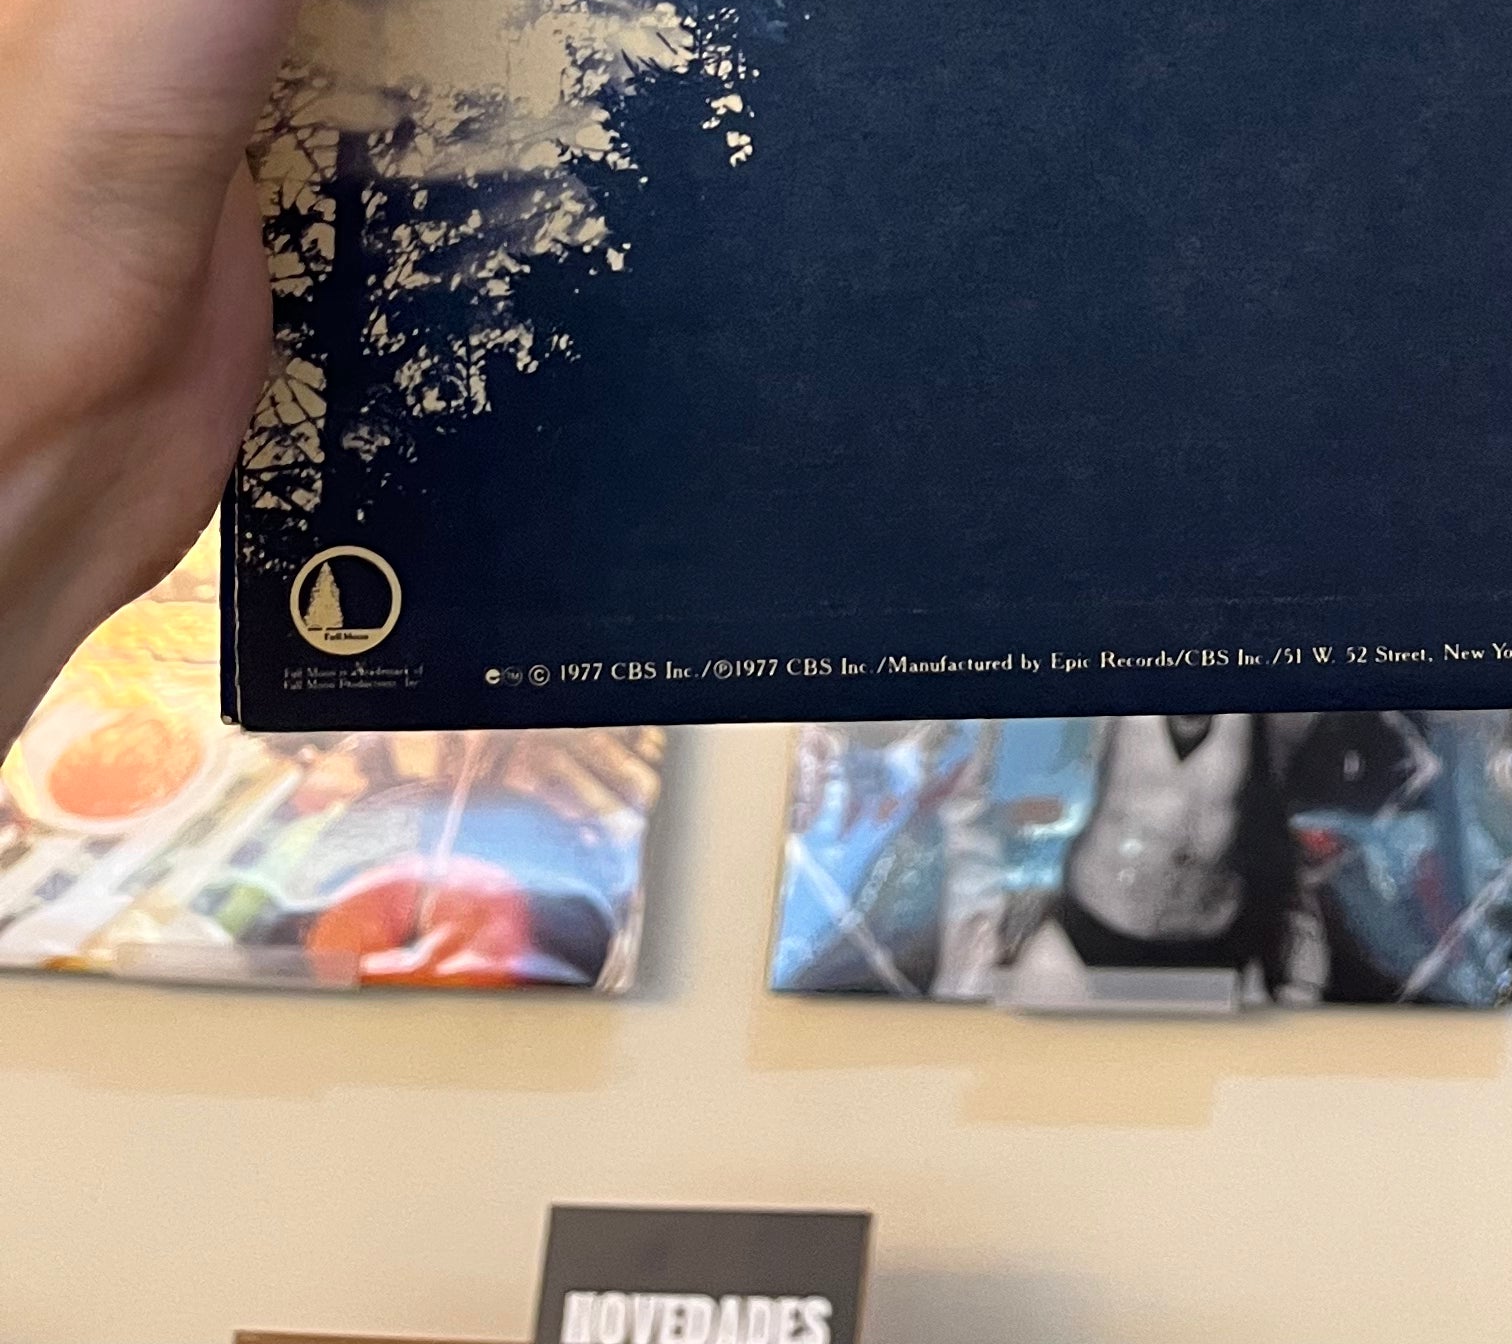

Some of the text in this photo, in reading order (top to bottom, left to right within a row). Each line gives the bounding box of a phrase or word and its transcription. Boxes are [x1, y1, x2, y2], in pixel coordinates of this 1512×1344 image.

[560, 662, 603, 681] 1977
[610, 661, 657, 680] CBS
[786, 657, 833, 676] CBS
[1021, 653, 1040, 673] by
[1051, 652, 1089, 673] Epic
[1100, 649, 1229, 669] Records/CBS
[1312, 646, 1336, 664] W.
[1346, 646, 1367, 664] 52
[1375, 646, 1433, 663] Street,
[1444, 643, 1485, 661] New
[560, 1289, 833, 1344] NOVEDADES
